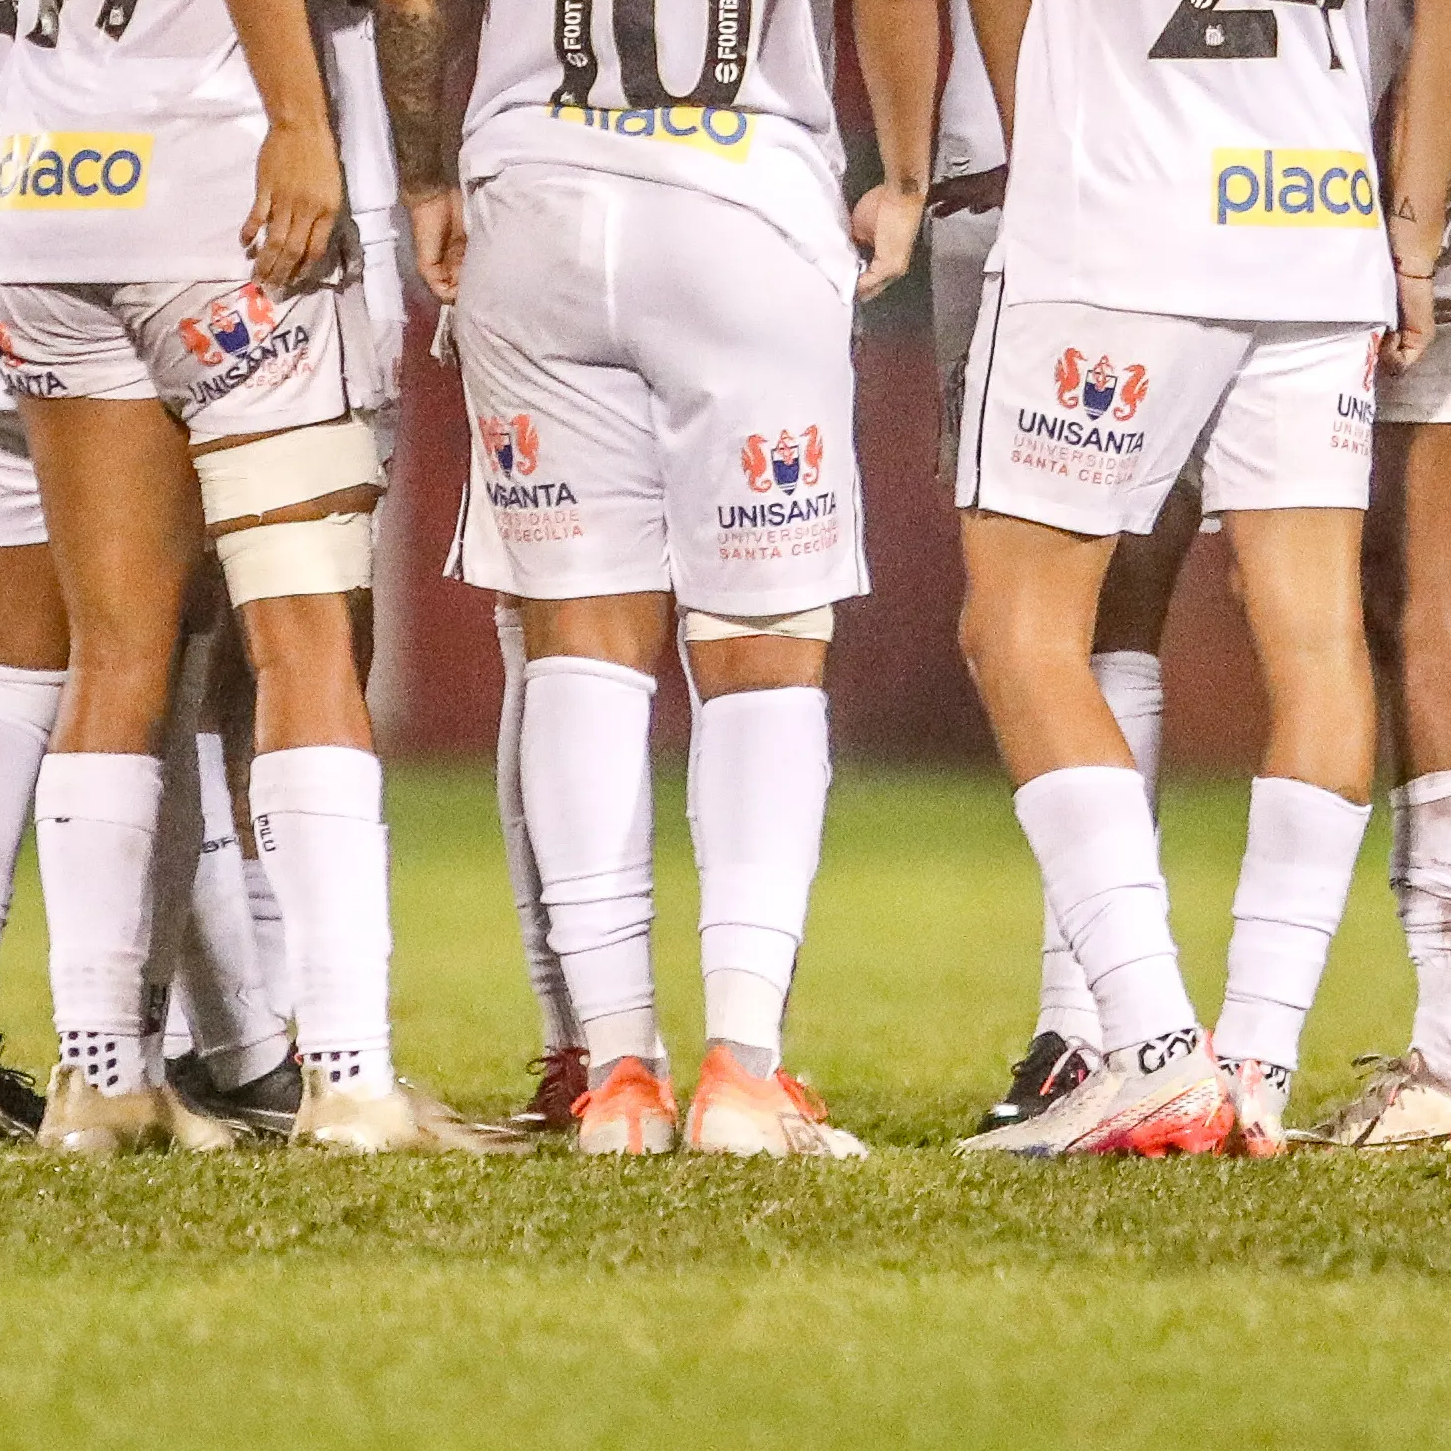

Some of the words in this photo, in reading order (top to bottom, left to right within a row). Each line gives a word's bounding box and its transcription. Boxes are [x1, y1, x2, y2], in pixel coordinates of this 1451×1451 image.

[1217, 150, 1374, 225] placo
[1018, 408, 1145, 454] UNISANTA
[1011, 449, 1069, 477] SANTA
[717, 491, 836, 529] UNISANTA
[719, 547, 783, 562] SANTA
